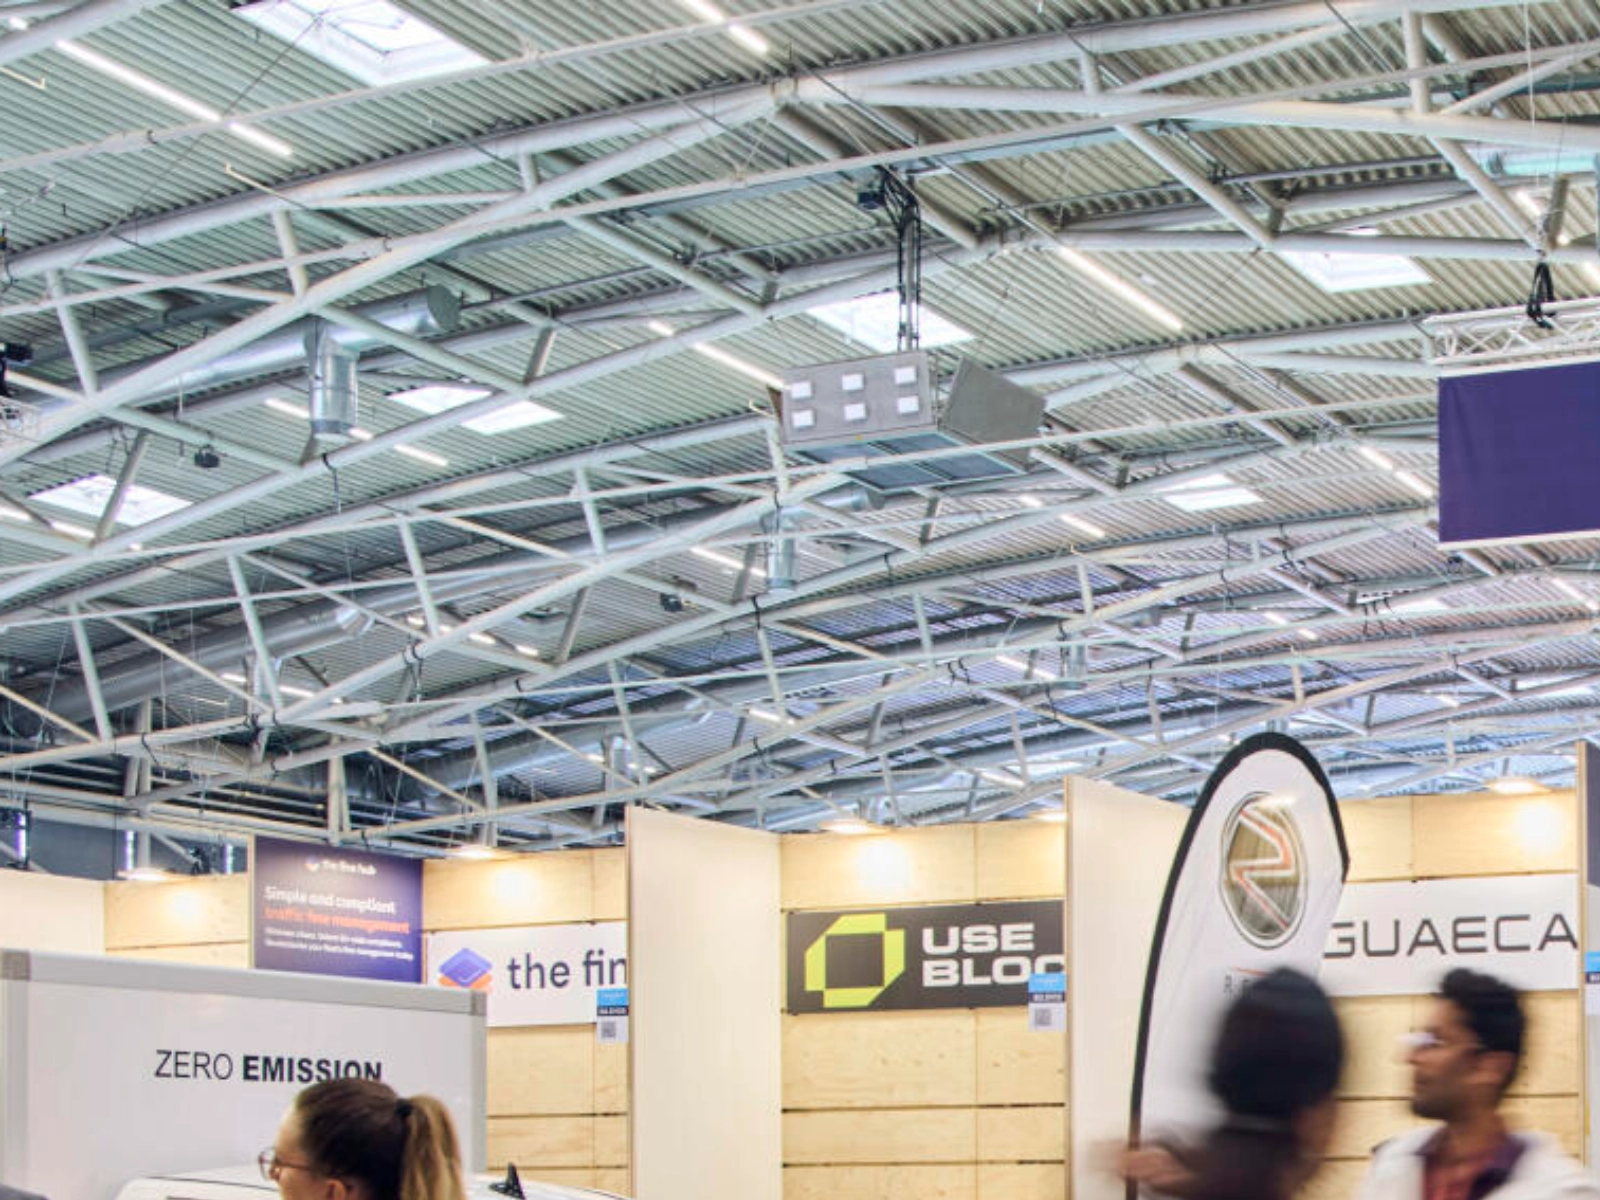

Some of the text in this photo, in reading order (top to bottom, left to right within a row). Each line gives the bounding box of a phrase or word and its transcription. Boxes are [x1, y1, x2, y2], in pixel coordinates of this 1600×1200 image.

[264, 885, 396, 915] Simple and compliant
[922, 922, 1035, 955] USE
[507, 952, 570, 990] the
[154, 1050, 382, 1083] ZERO EMISSION
